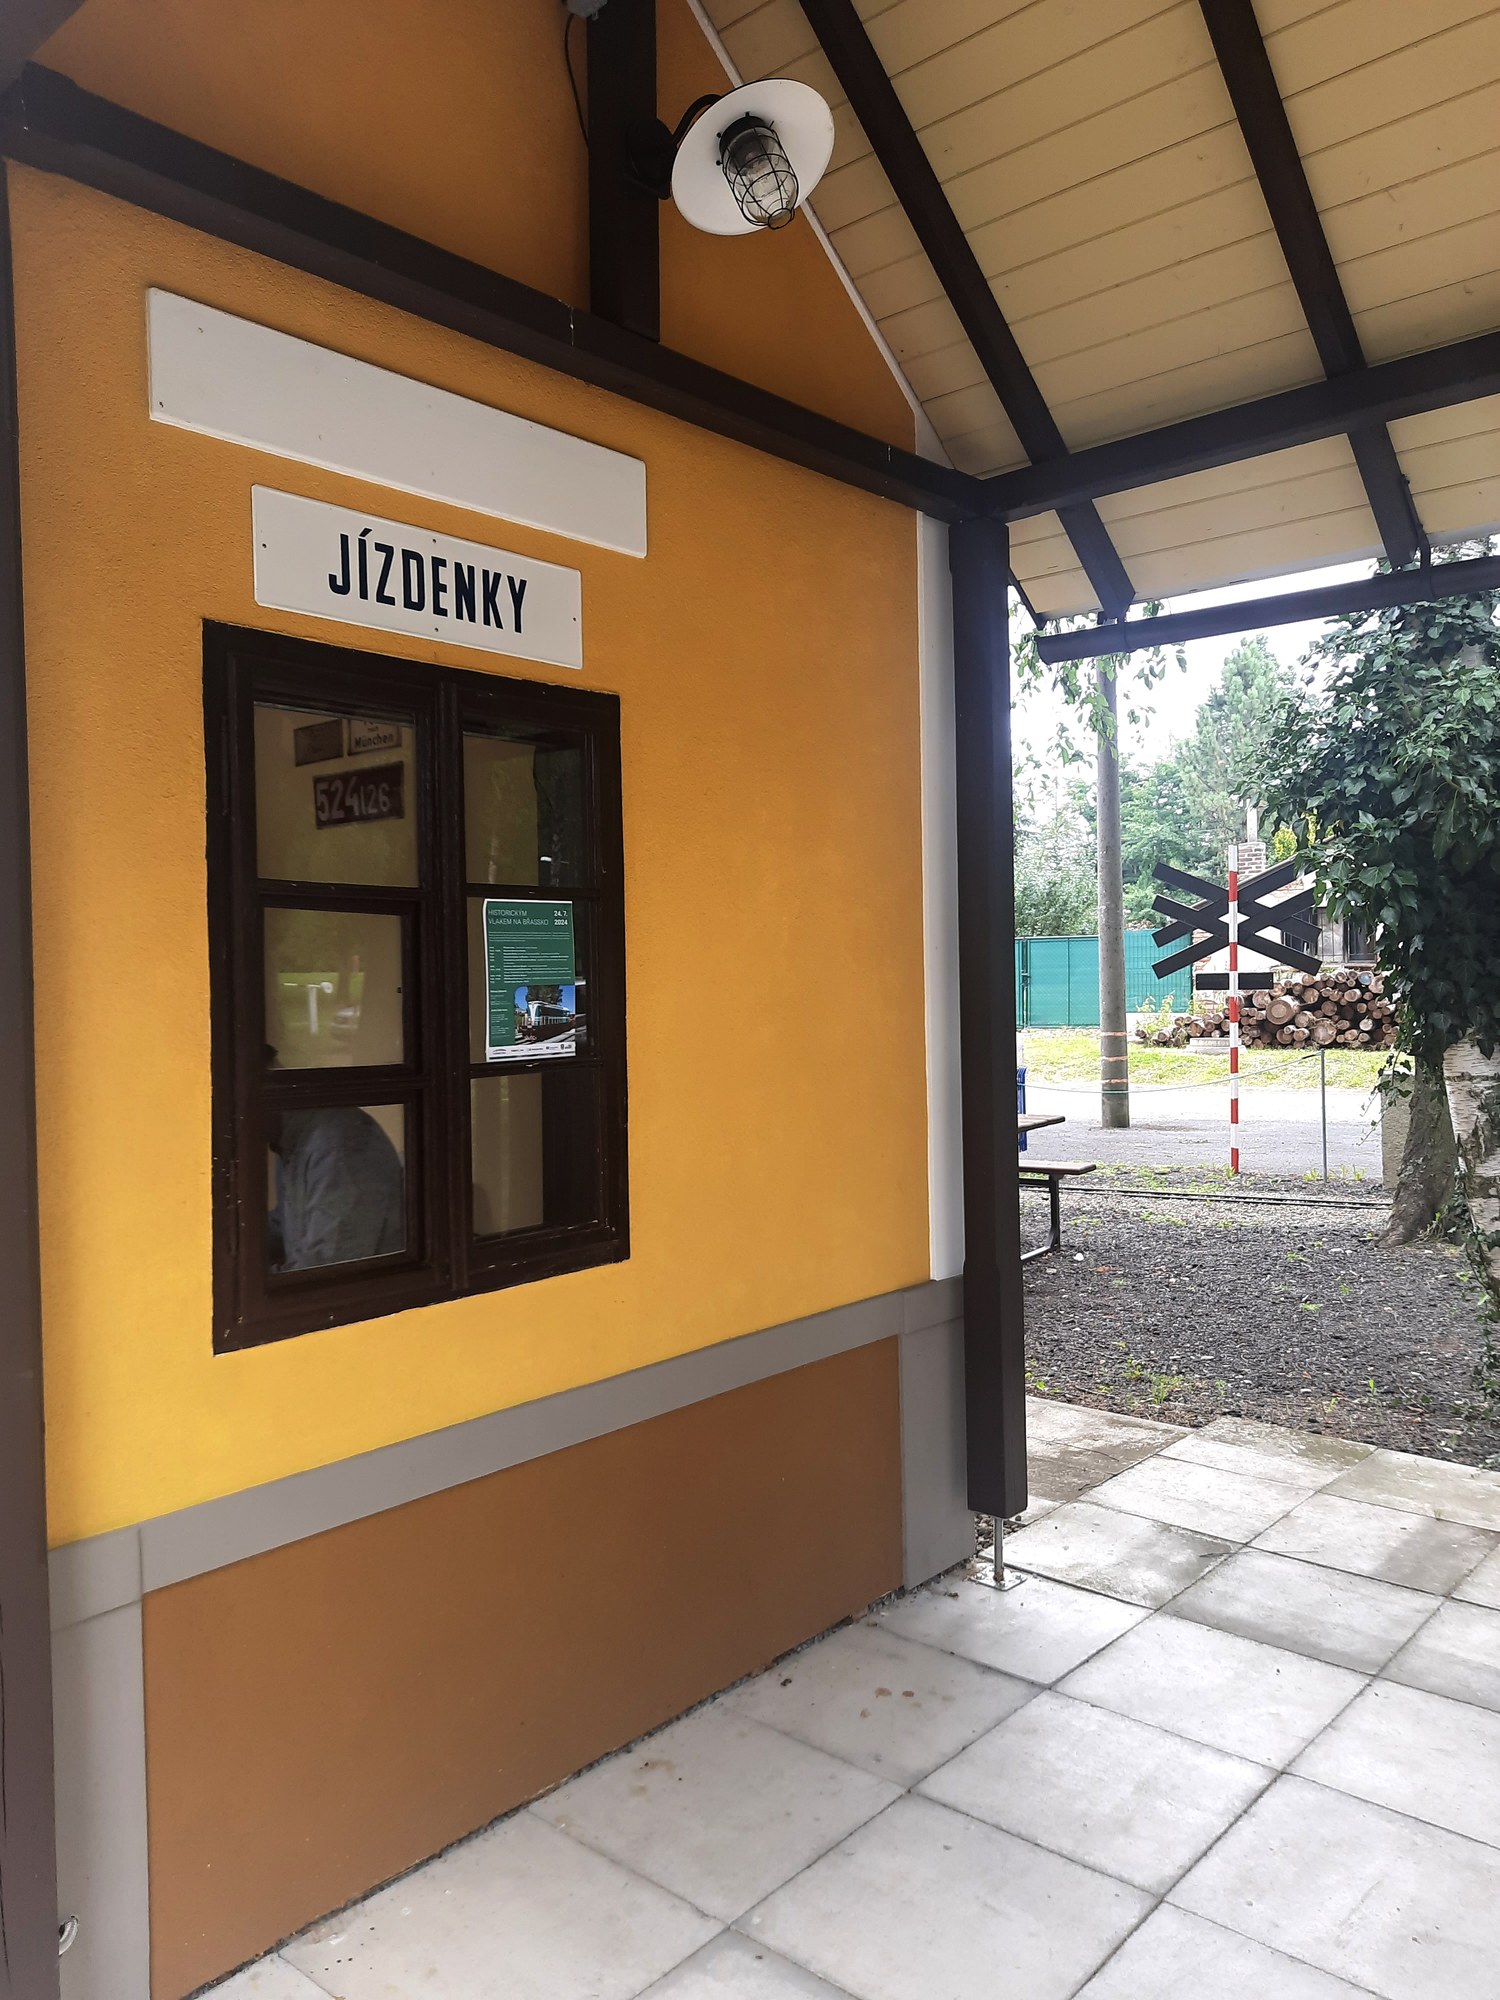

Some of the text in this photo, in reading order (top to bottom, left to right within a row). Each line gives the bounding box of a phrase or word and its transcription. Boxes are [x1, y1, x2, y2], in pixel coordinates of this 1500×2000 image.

[328, 527, 527, 634] JÍZDENKY
[354, 733, 394, 748] München
[488, 909, 528, 917] HISTORICKÝM
